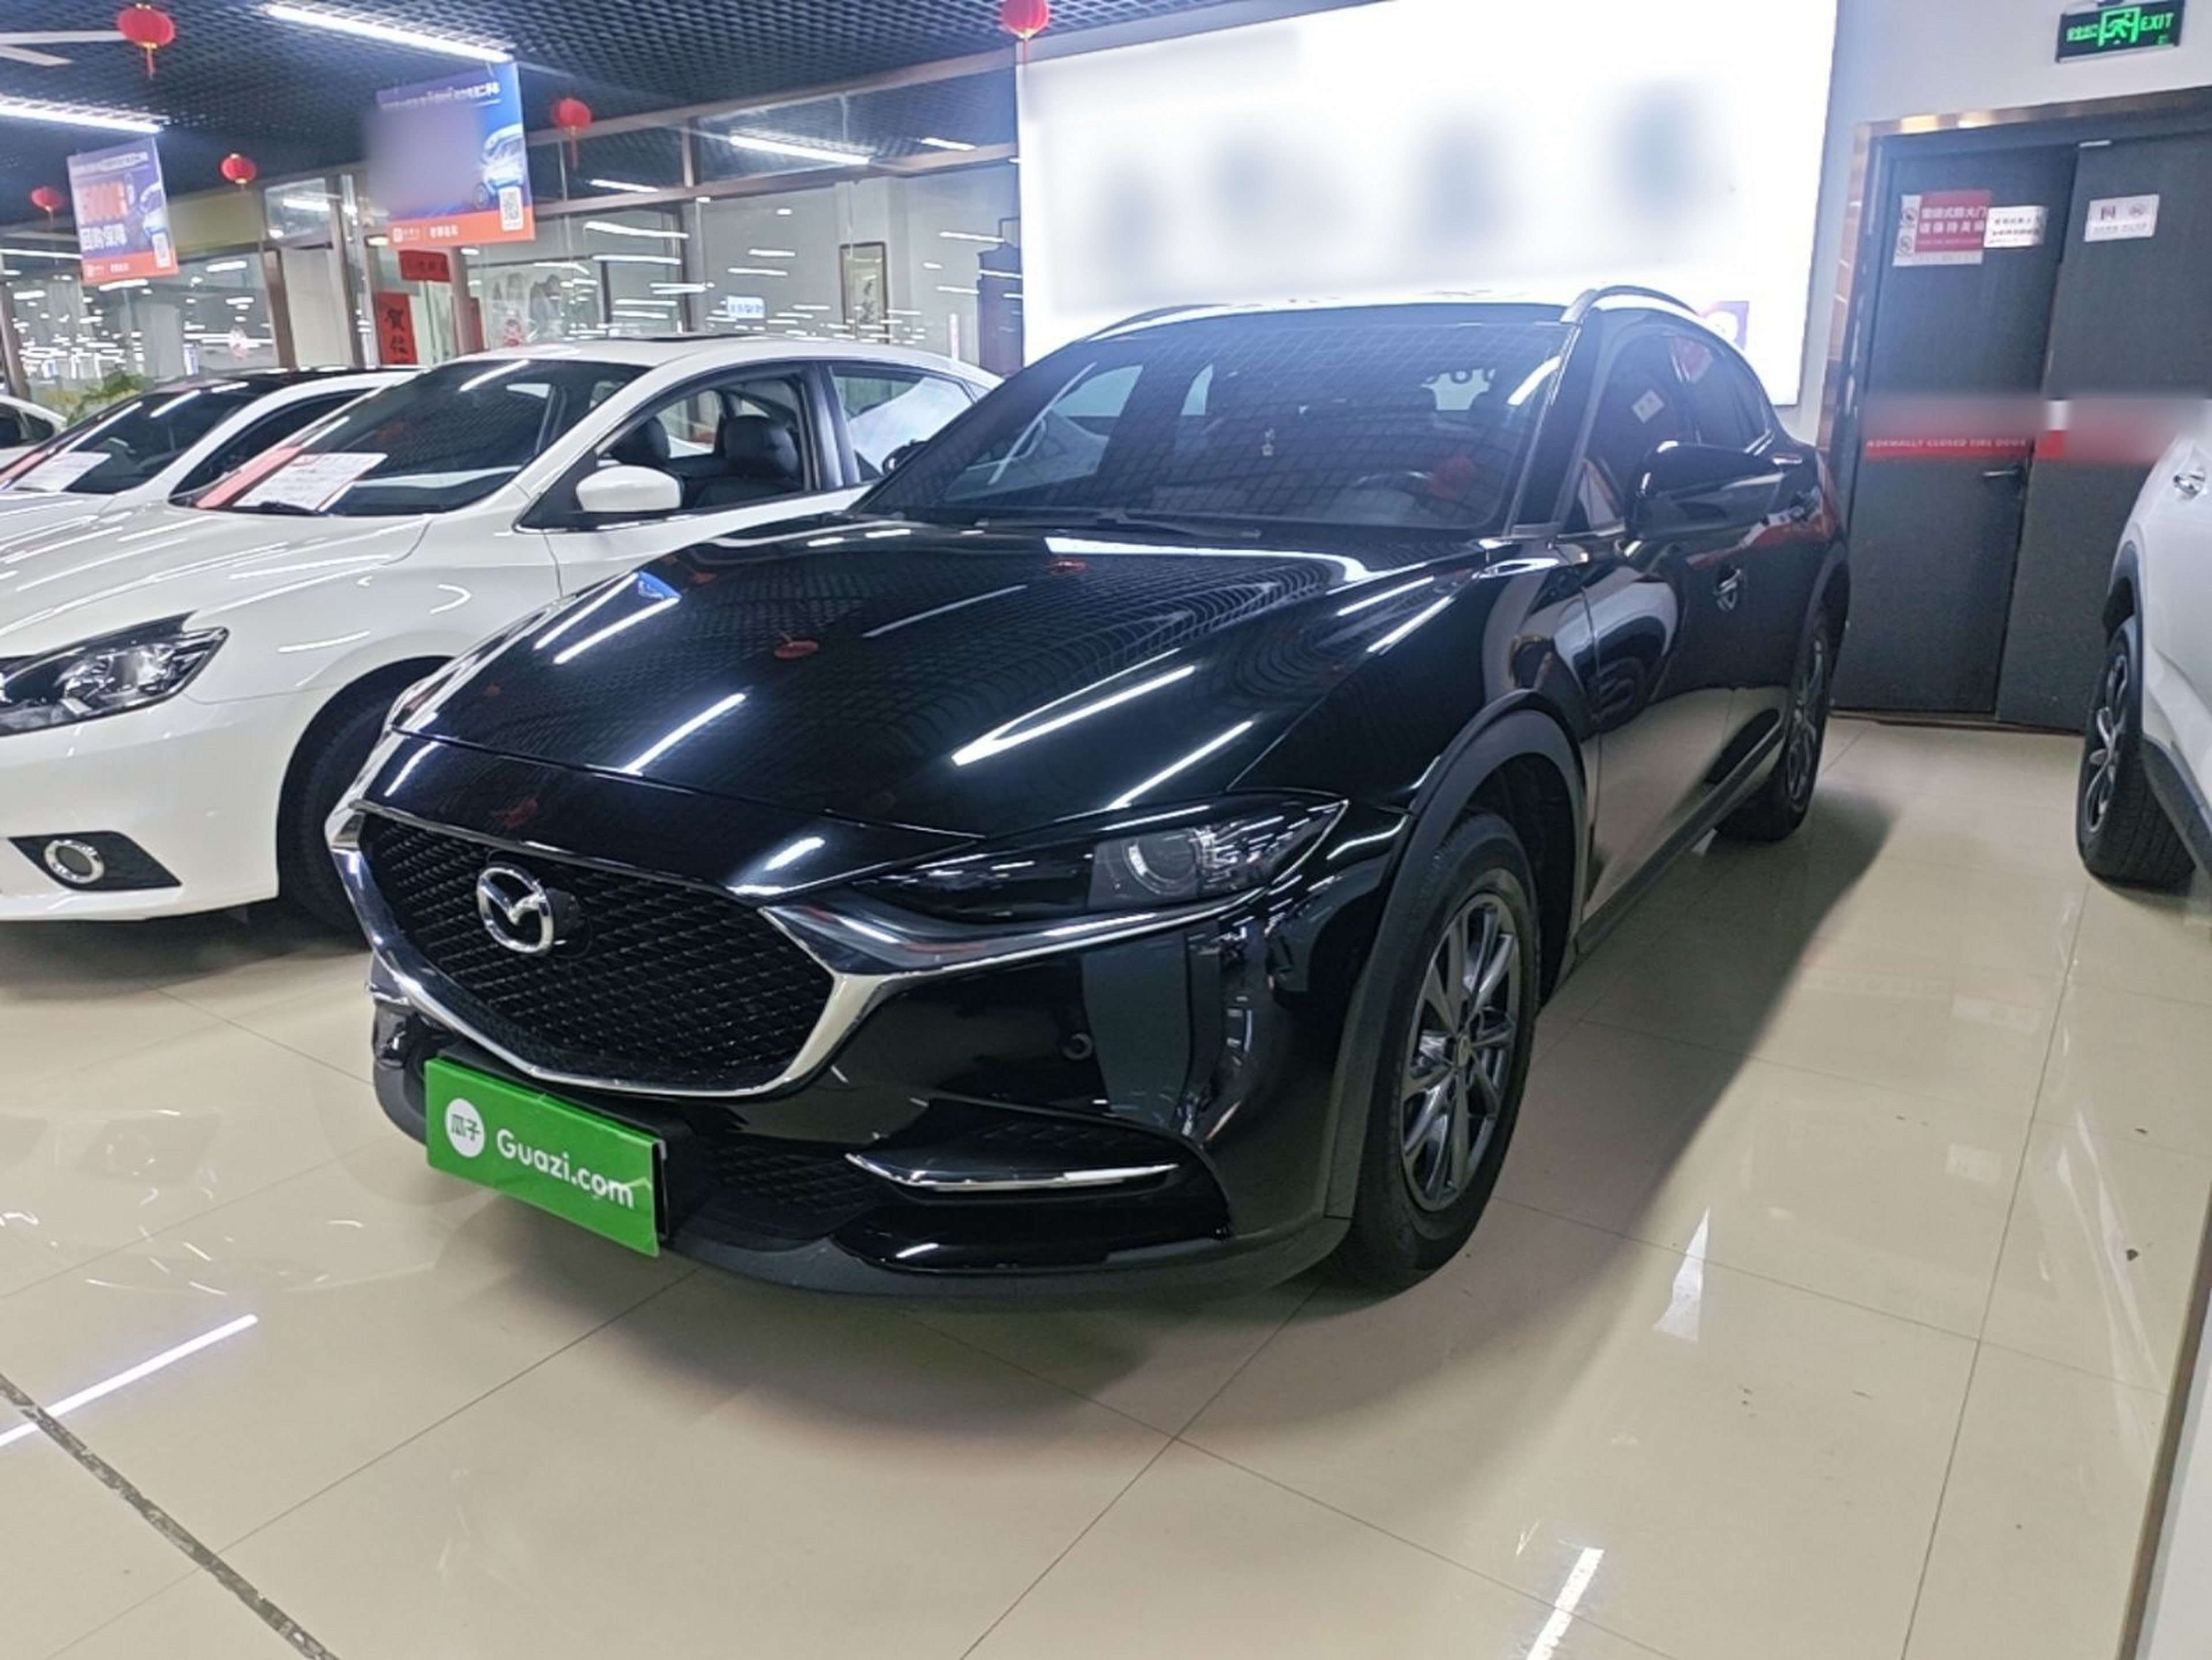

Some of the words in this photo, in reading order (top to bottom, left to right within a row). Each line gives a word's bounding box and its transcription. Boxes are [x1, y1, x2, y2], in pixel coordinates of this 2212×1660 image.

[2140, 13, 2174, 31] EXIT
[451, 1113, 482, 1142] 瓜子
[497, 1128, 634, 1209] Guazi.com
